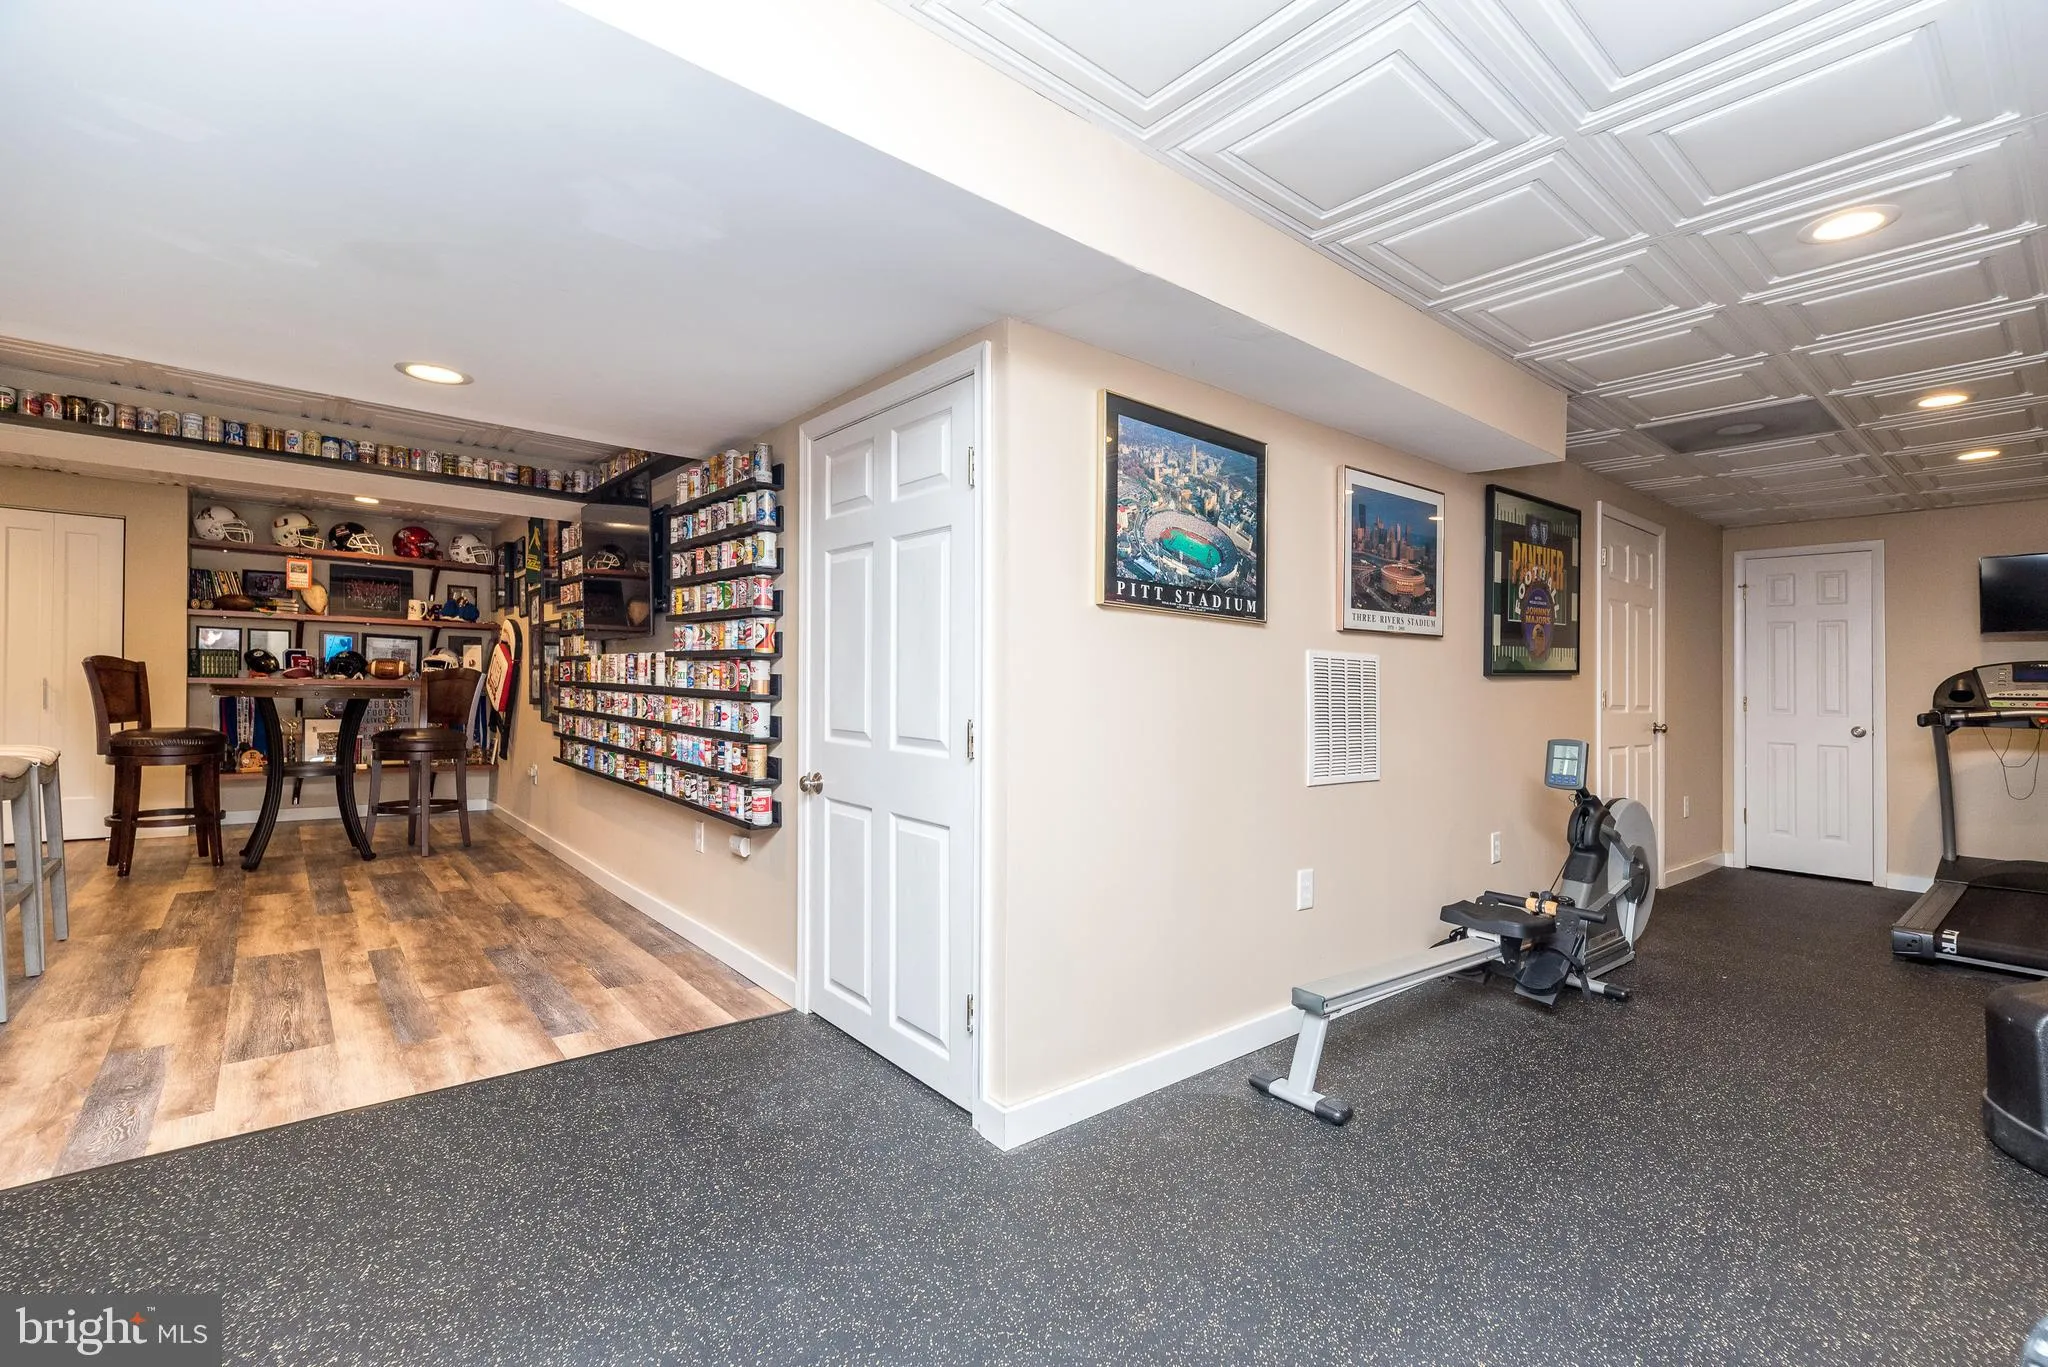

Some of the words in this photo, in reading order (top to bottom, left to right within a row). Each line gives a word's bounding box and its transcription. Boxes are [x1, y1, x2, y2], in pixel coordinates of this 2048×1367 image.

[1512, 540, 1564, 591] PANTHER
[1116, 580, 1164, 601] PITT
[1175, 589, 1257, 613] STADIUM
[1525, 606, 1551, 616] JOHNNY
[1352, 612, 1376, 623] THREE
[1379, 615, 1405, 625] RIVERS
[1407, 617, 1436, 628] STADIUM
[1525, 615, 1552, 624] MAJORS
[384, 700, 408, 708] EST
